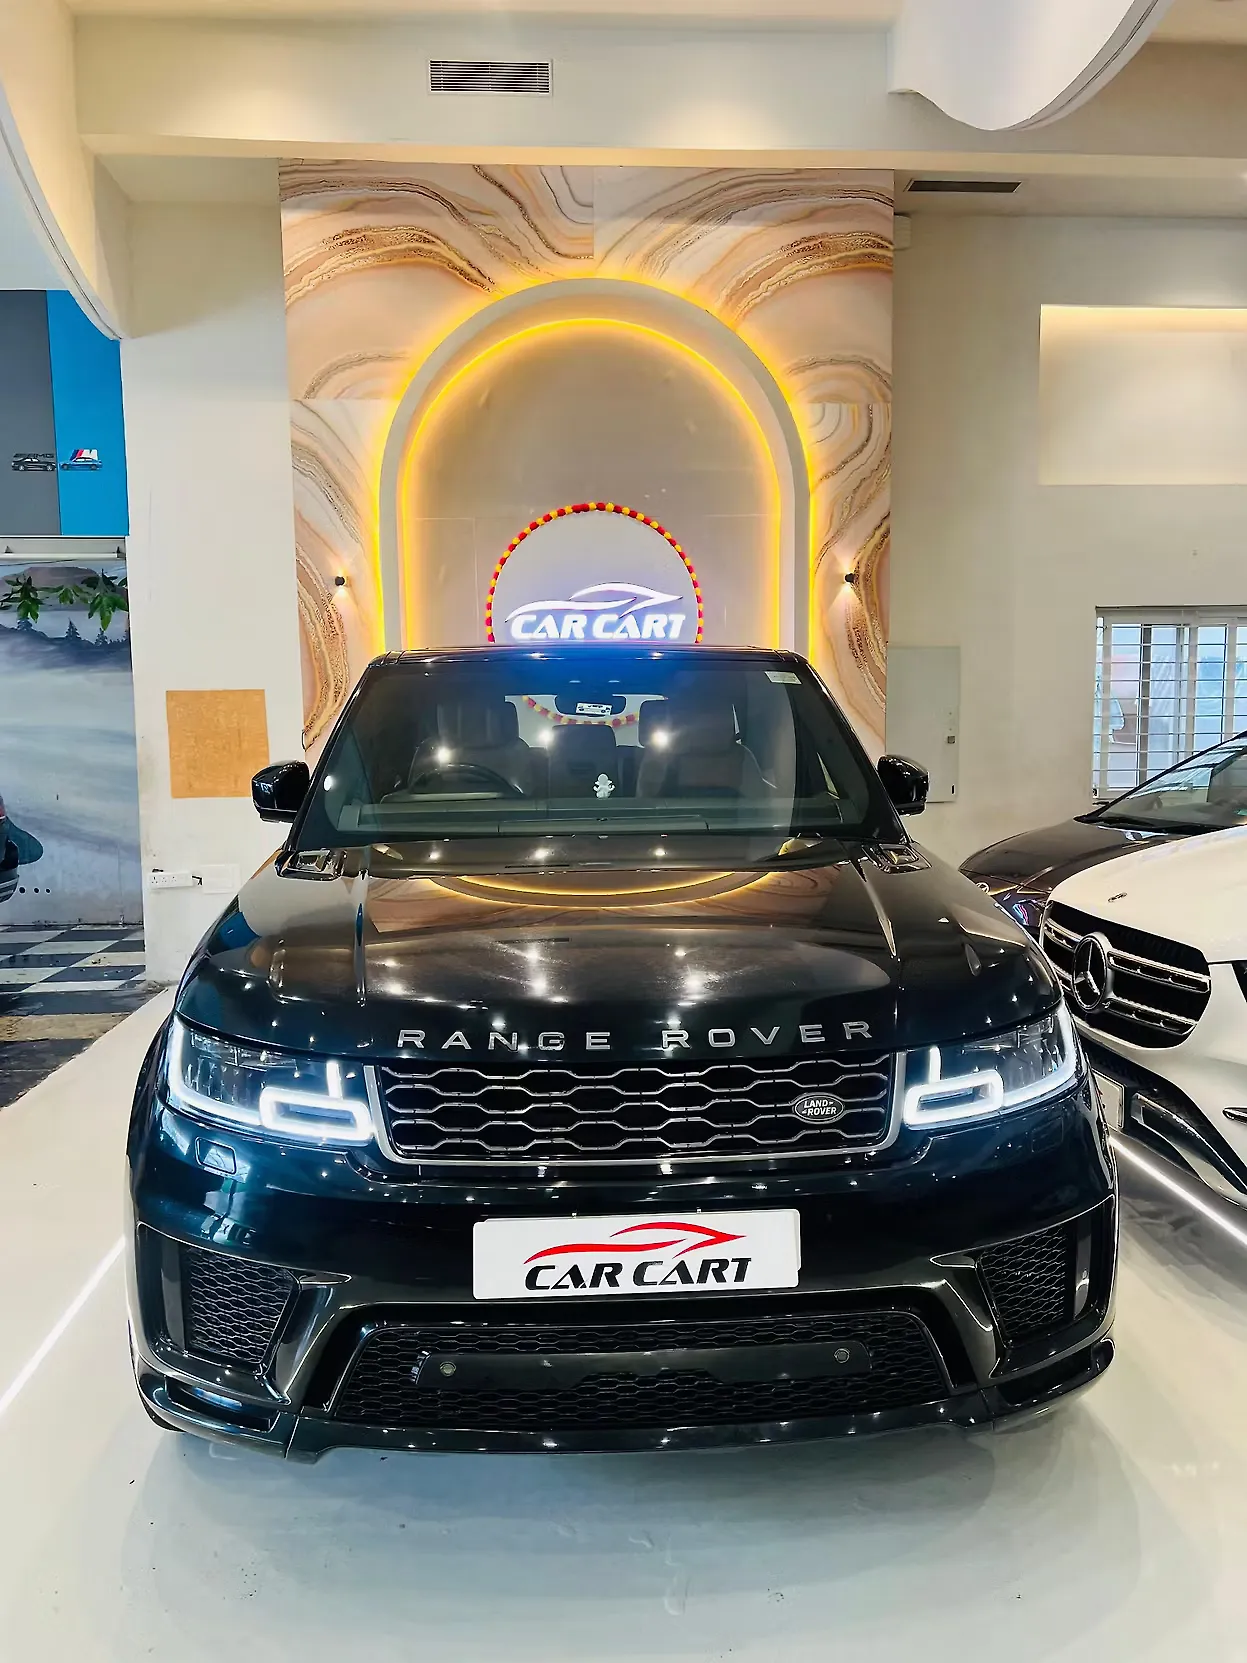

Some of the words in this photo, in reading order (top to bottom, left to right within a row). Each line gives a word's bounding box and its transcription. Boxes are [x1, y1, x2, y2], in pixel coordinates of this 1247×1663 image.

[511, 614, 587, 639] CAR
[592, 614, 685, 639] CART
[397, 1029, 611, 1051] RANGE
[661, 1021, 872, 1048] ROVER
[804, 1100, 828, 1108] LAND
[807, 1107, 837, 1116] ROVER
[525, 1262, 623, 1290] CAR
[632, 1257, 752, 1287] CART
